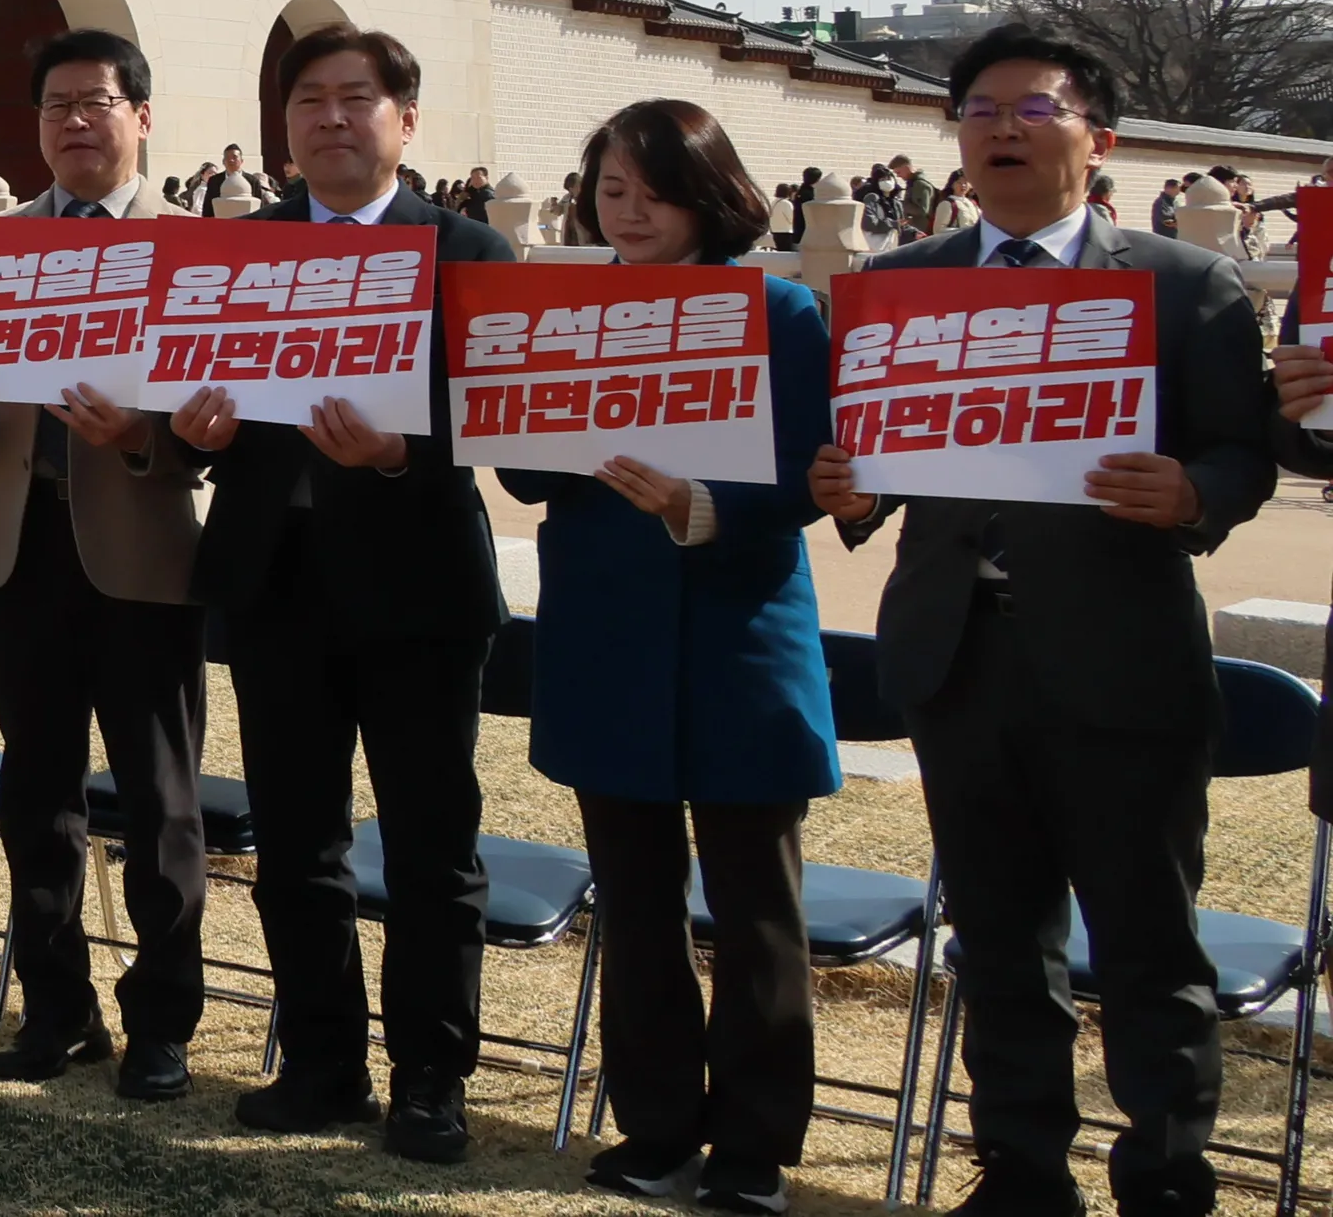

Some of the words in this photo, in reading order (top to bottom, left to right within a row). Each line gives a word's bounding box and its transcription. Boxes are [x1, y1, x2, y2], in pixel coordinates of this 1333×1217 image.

[162, 250, 421, 316] 윤석열을
[147, 320, 423, 382] 파면하라!
[464, 292, 749, 368] 윤석열을
[837, 298, 1134, 387] 윤석열을
[460, 365, 760, 438] 파면하라!
[835, 377, 1145, 458] 파면하라!
